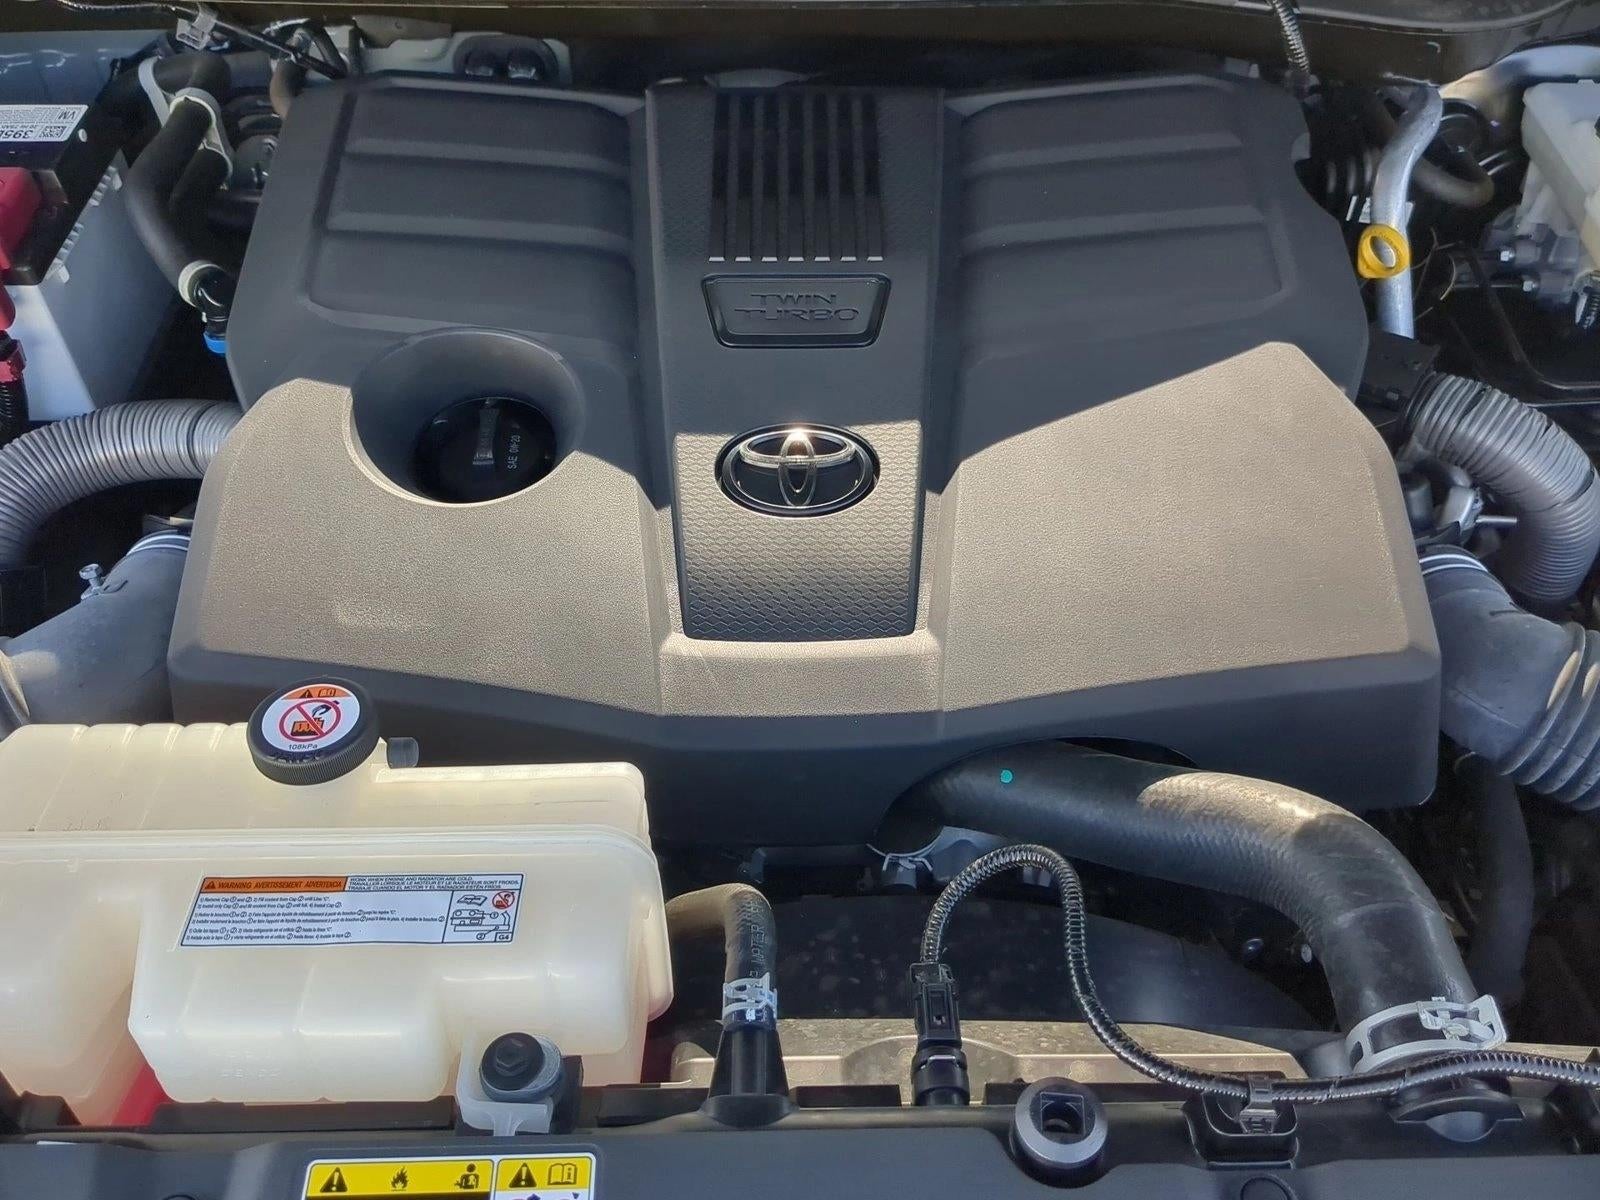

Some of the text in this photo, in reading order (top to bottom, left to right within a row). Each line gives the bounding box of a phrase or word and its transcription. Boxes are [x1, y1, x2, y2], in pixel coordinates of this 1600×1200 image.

[57, 110, 76, 120] VM
[750, 293, 837, 305] TWIN
[734, 308, 860, 321] TURBO
[507, 434, 521, 472] SAE 0W-20
[218, 881, 251, 889] WARNING
